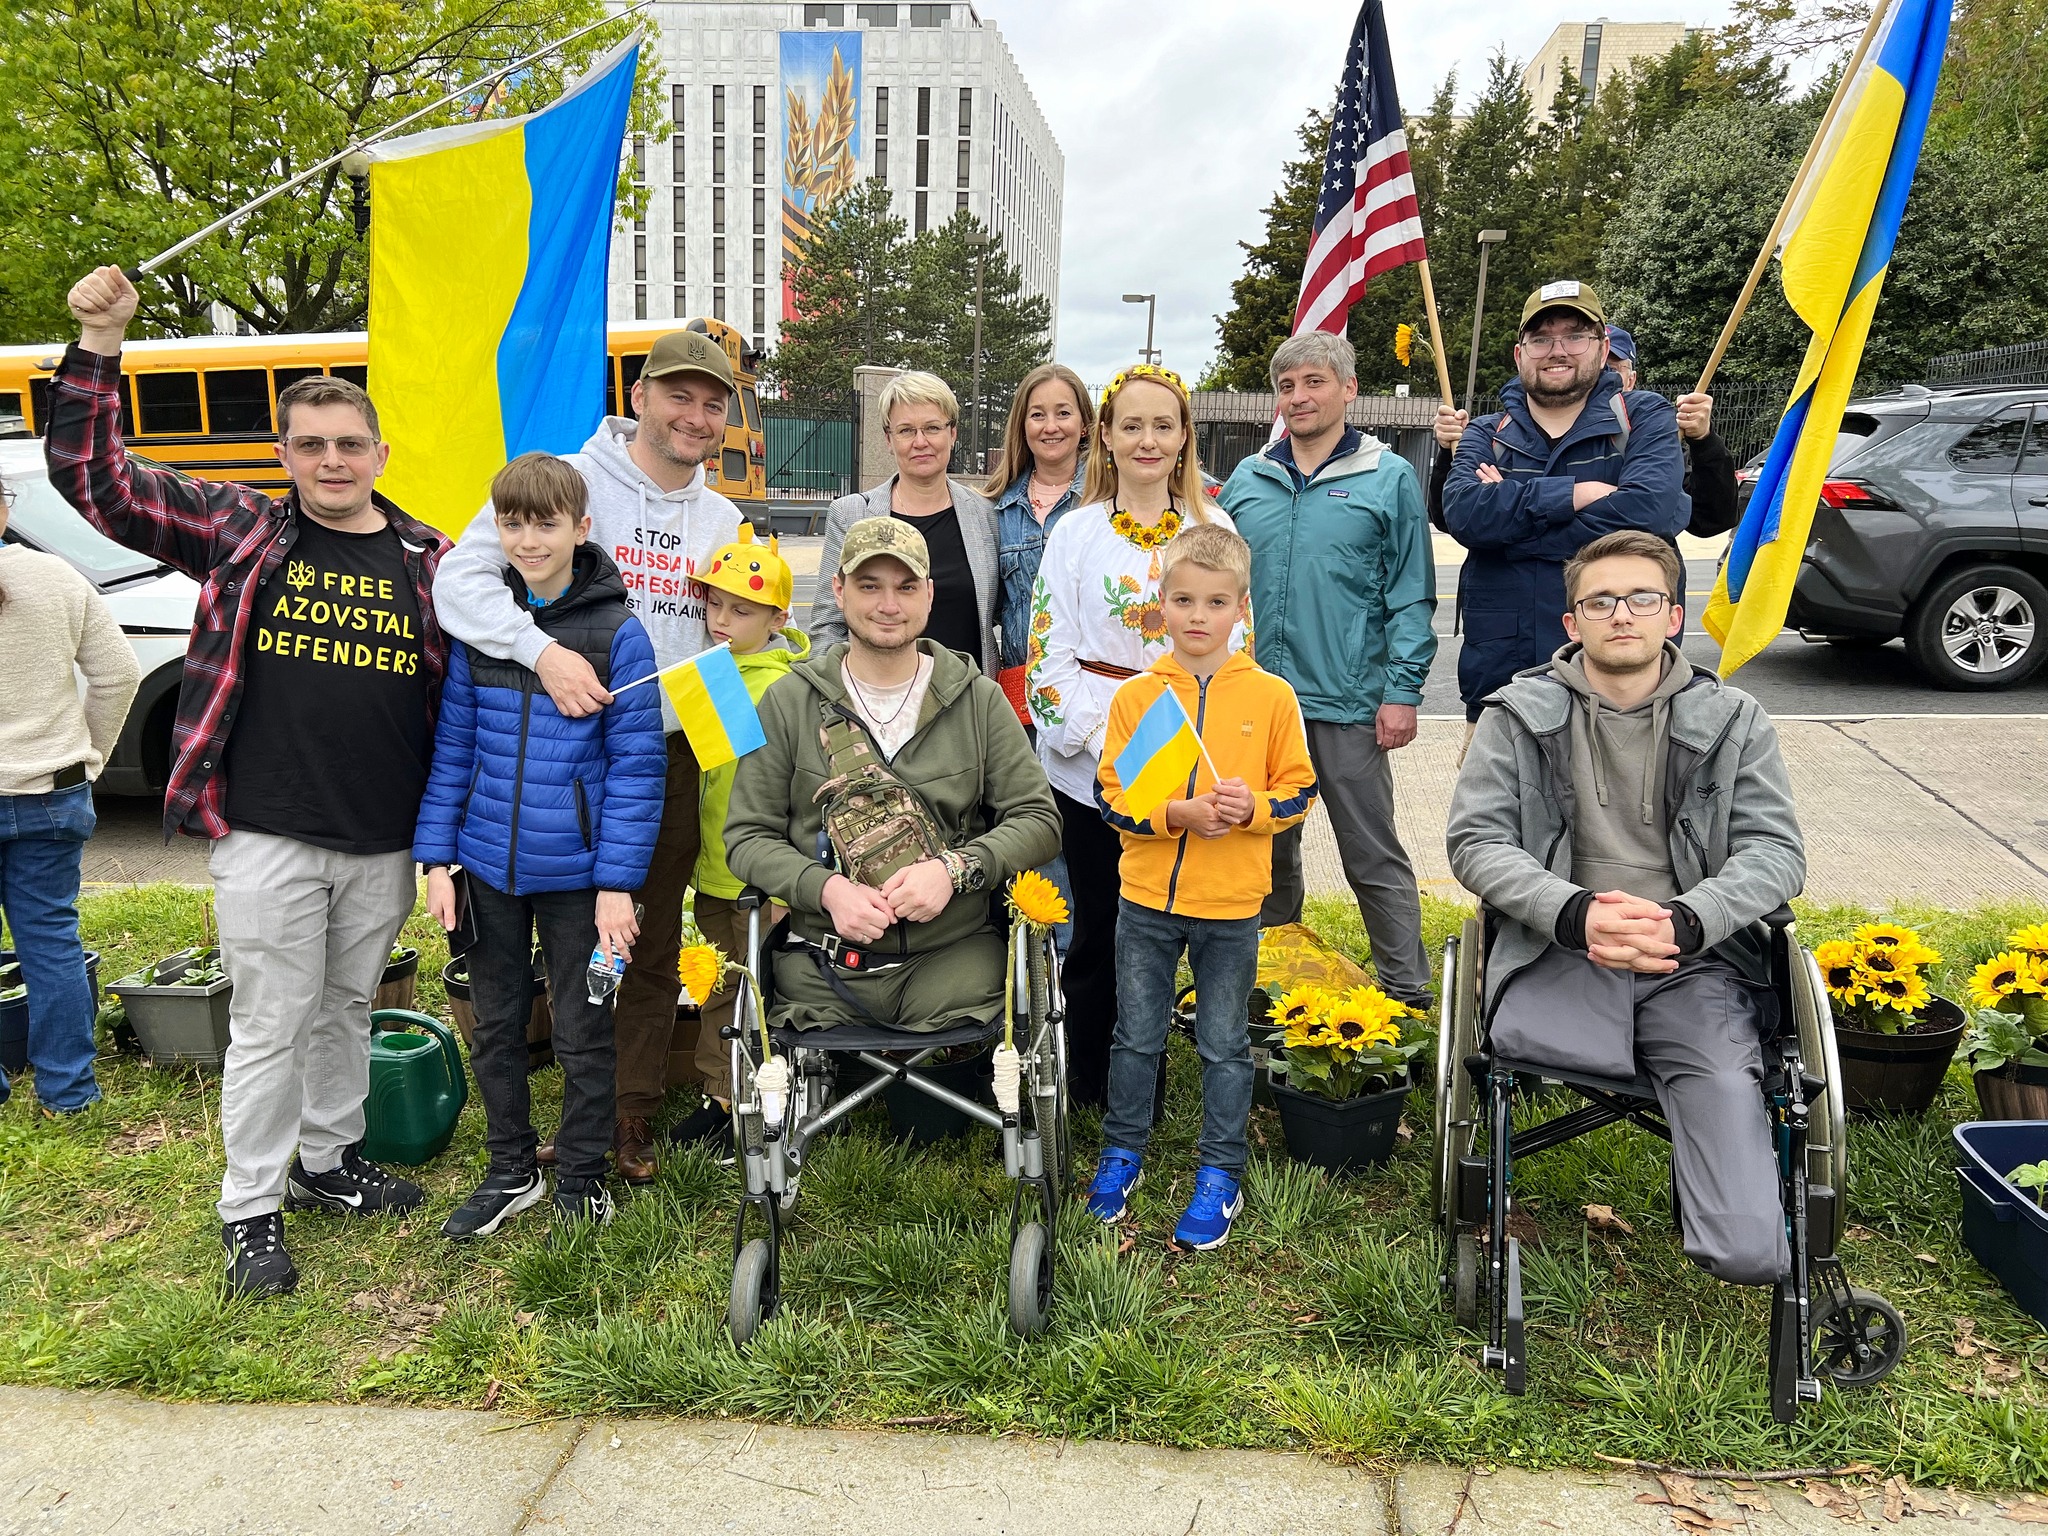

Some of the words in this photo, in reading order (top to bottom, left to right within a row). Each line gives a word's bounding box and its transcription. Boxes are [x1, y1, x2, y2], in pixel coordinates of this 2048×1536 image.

[634, 528, 681, 550] STOP
[615, 545, 695, 576] RUSSIAN
[323, 572, 393, 600] FREE
[621, 570, 708, 602] GRESSION
[272, 595, 415, 639] AZOVSTAL
[257, 628, 418, 676] DEFENDERS
